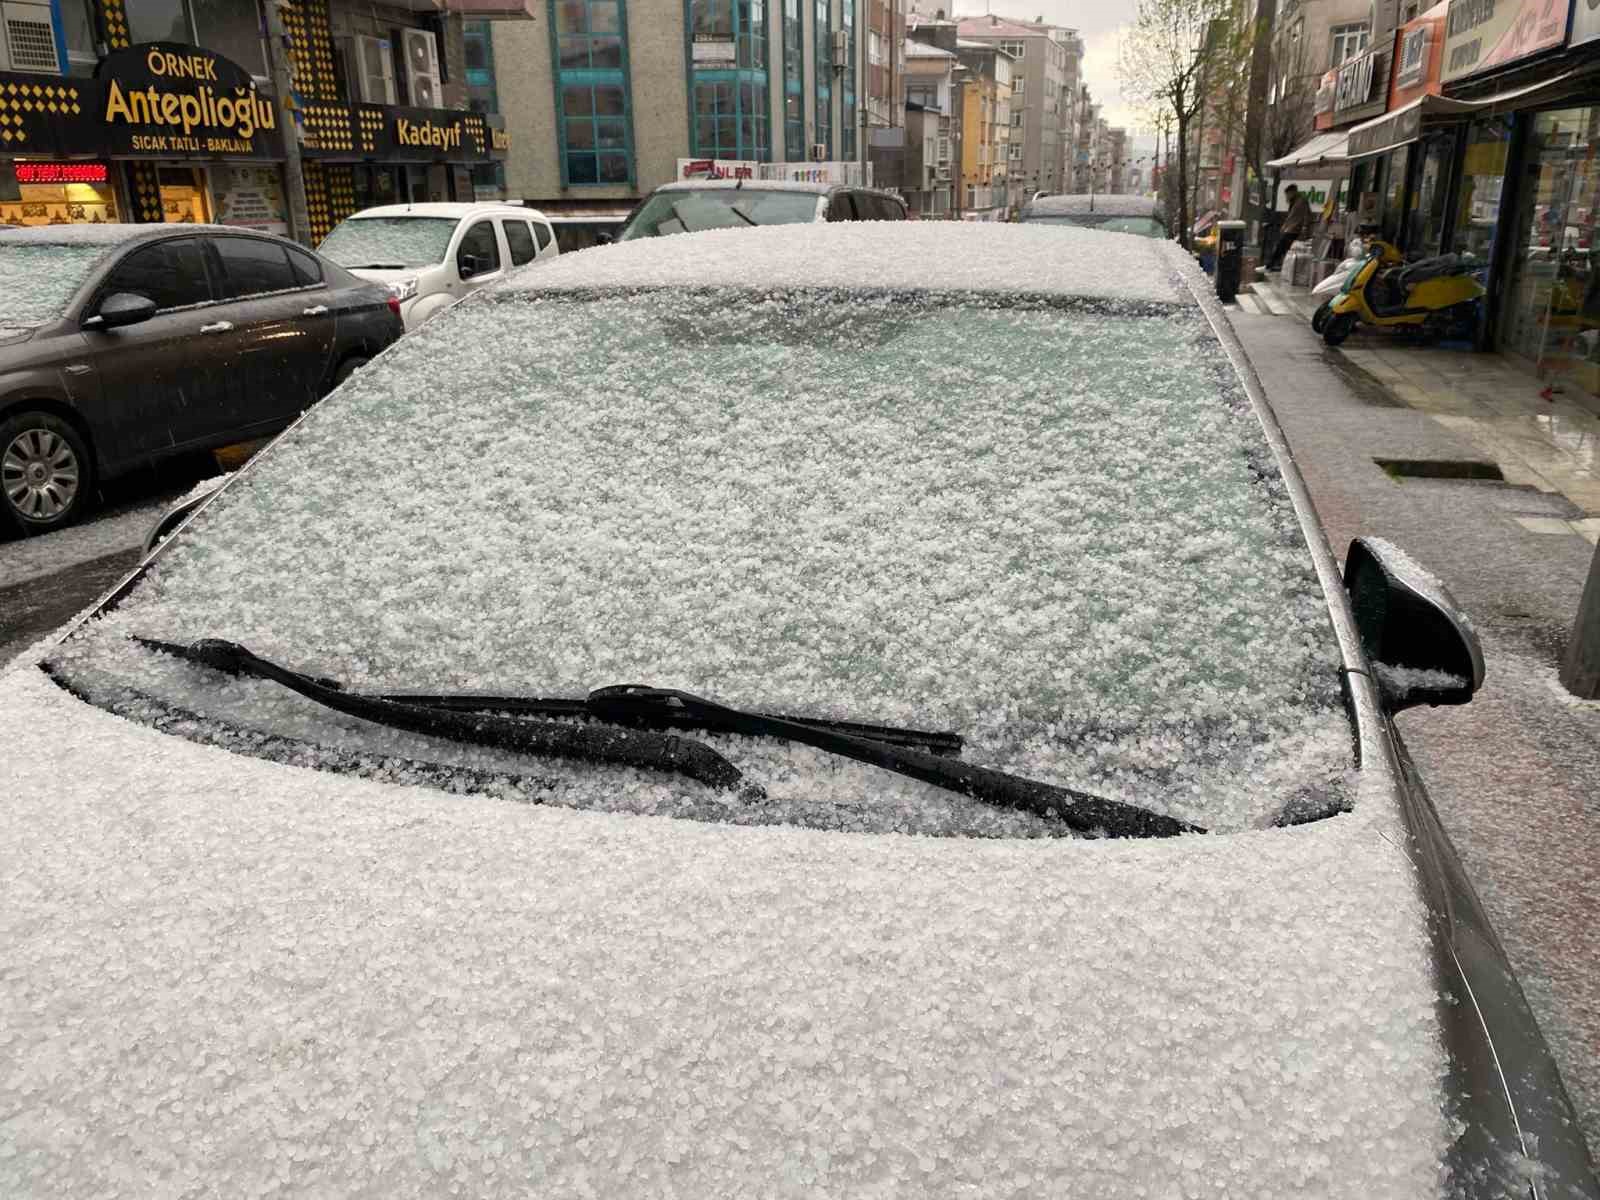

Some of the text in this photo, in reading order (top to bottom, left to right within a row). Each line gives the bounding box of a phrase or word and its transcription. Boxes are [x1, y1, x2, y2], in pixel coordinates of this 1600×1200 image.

[148, 46, 218, 80] ÖRNEK
[106, 79, 275, 138] Anteplioğlu
[131, 135, 168, 151] SICAK
[169, 137, 200, 151] TATLI
[207, 138, 254, 153] BAKLAVA
[397, 118, 461, 152] Kadayıf
